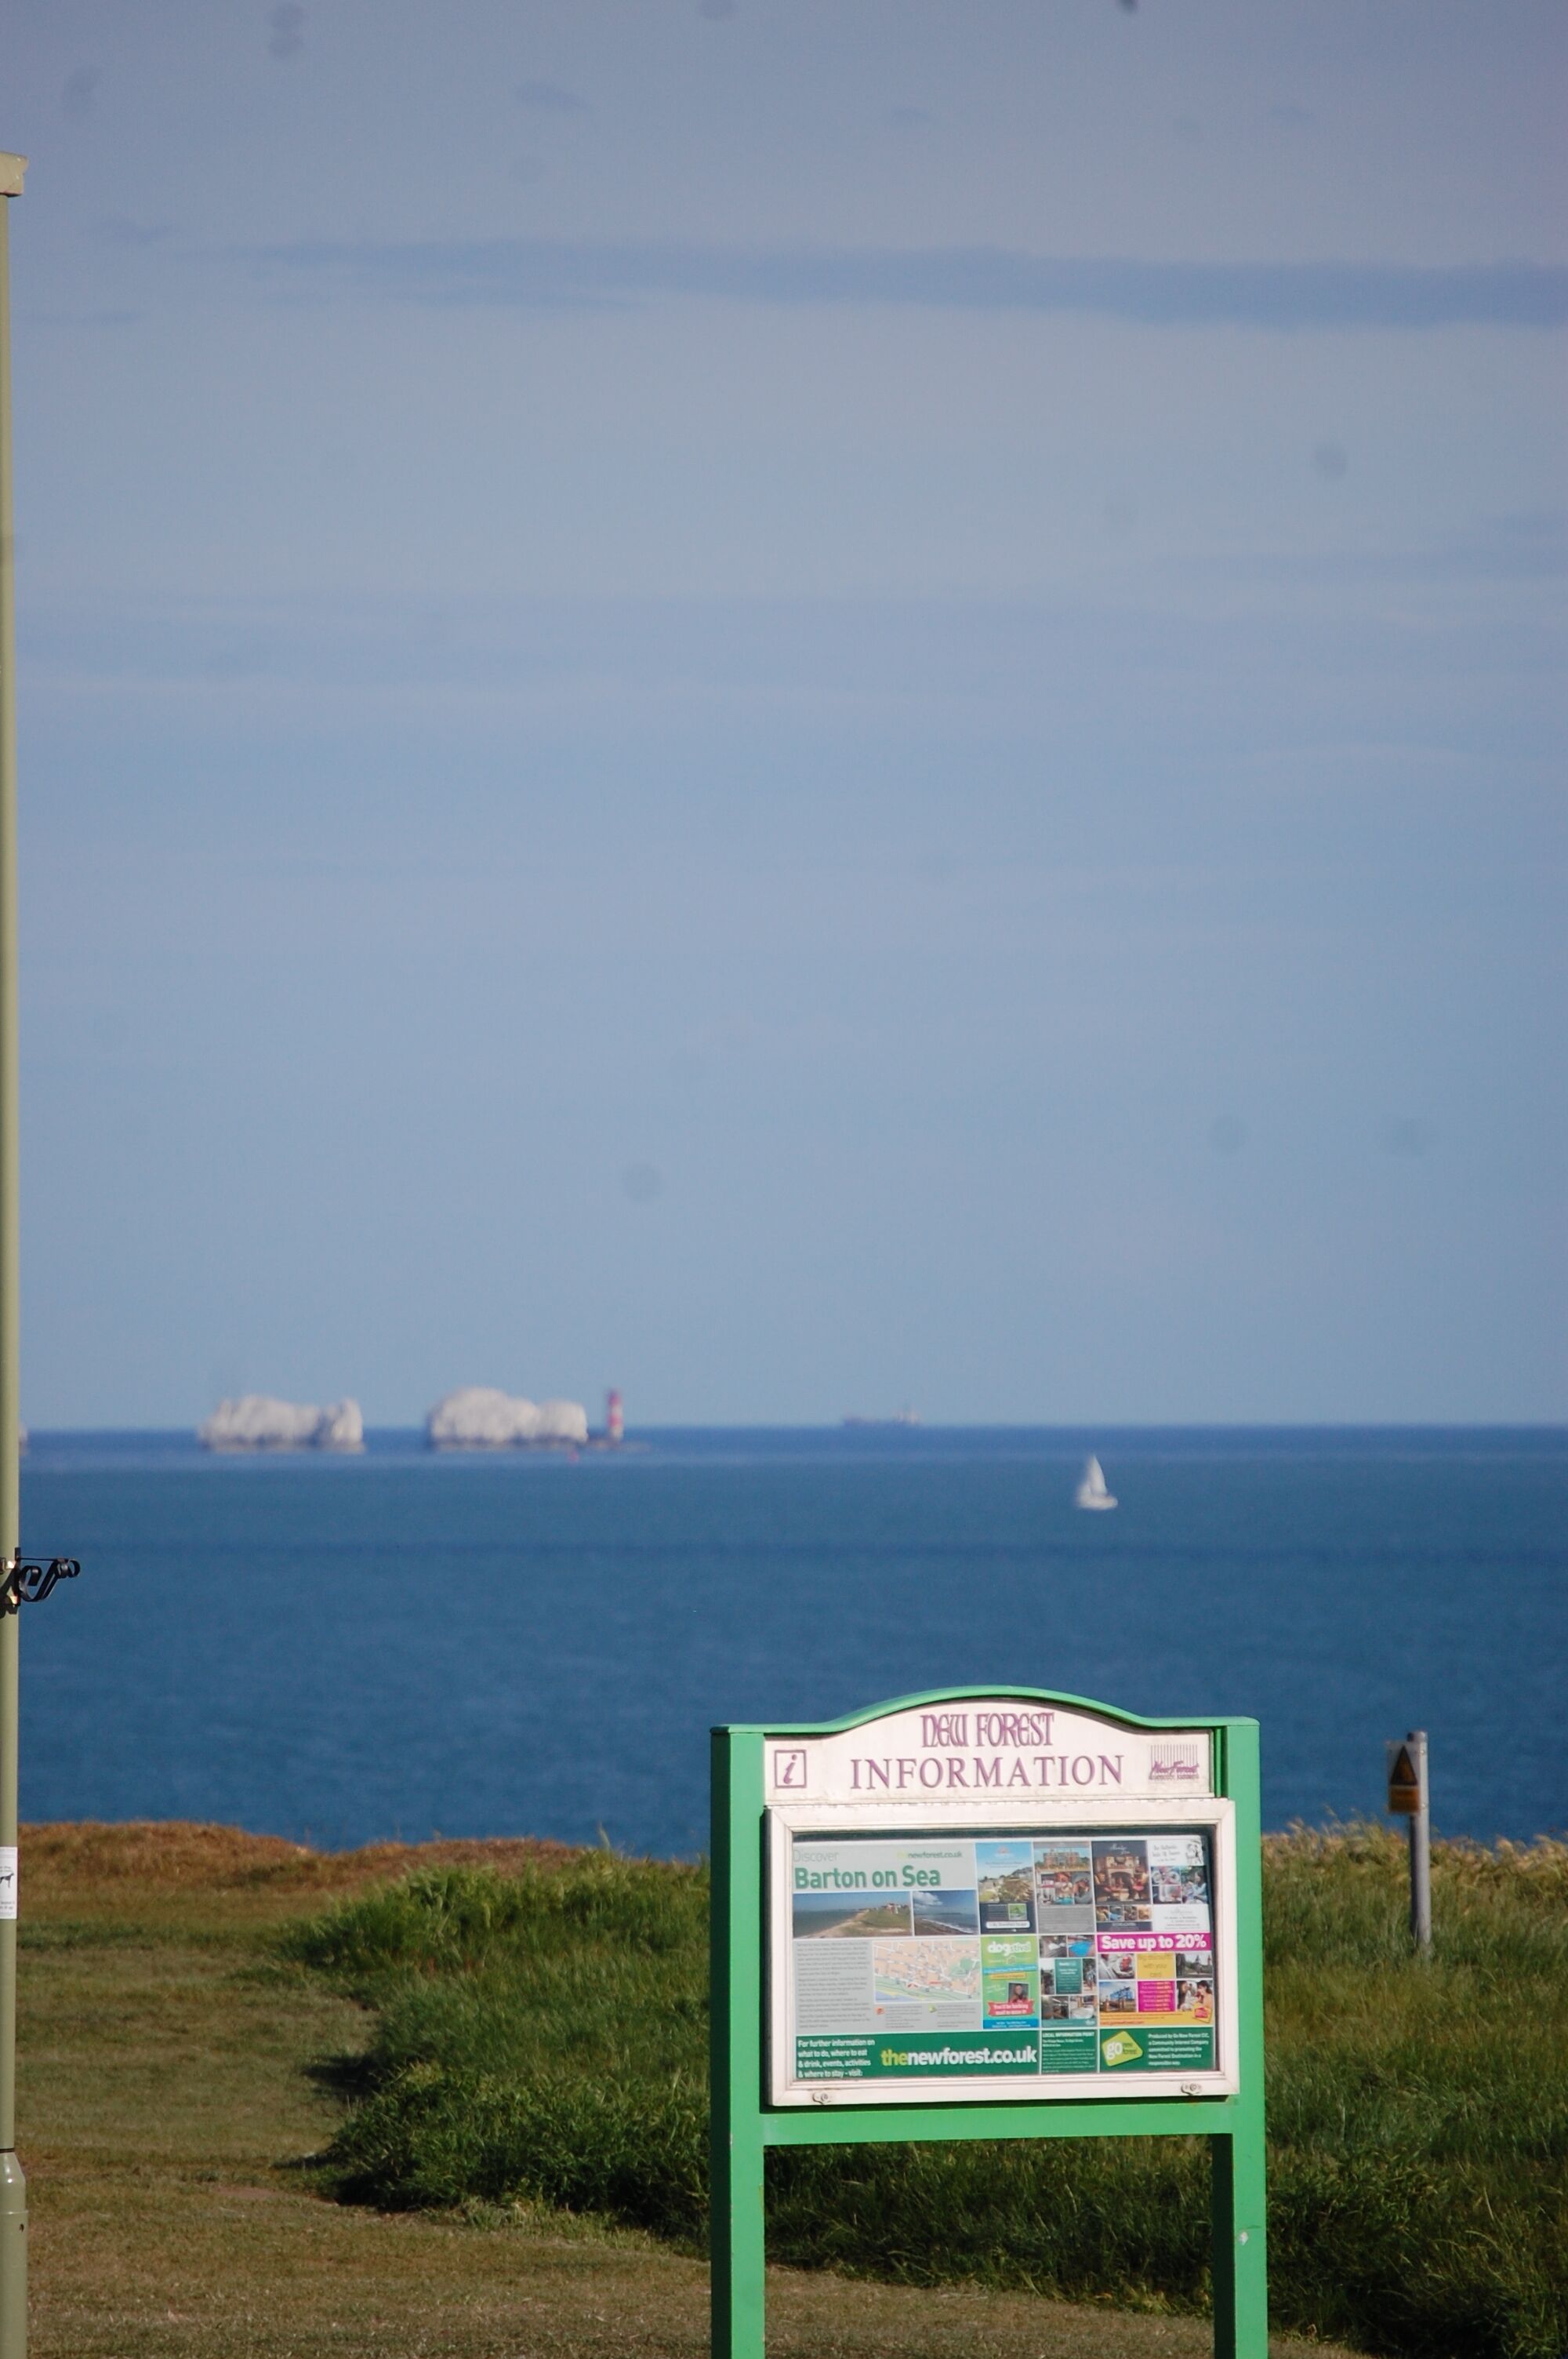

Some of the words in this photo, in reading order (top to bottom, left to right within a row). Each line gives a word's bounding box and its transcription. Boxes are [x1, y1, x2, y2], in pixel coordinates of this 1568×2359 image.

[920, 1714, 970, 1747] NEW
[975, 1712, 1055, 1747] FOREST
[851, 1755, 1124, 1789] INFORMATION
[794, 1867, 867, 1889] Barton
[872, 1870, 898, 1888] on
[902, 1865, 941, 1887] Sea
[1102, 1936, 1136, 1950] Save
[1138, 1937, 1156, 1952] up
[1159, 1936, 1174, 1948] to
[1175, 1934, 1207, 1948] 20%
[880, 2045, 1038, 2066] thenewforest.co.uk
[1106, 2041, 1123, 2060] go
